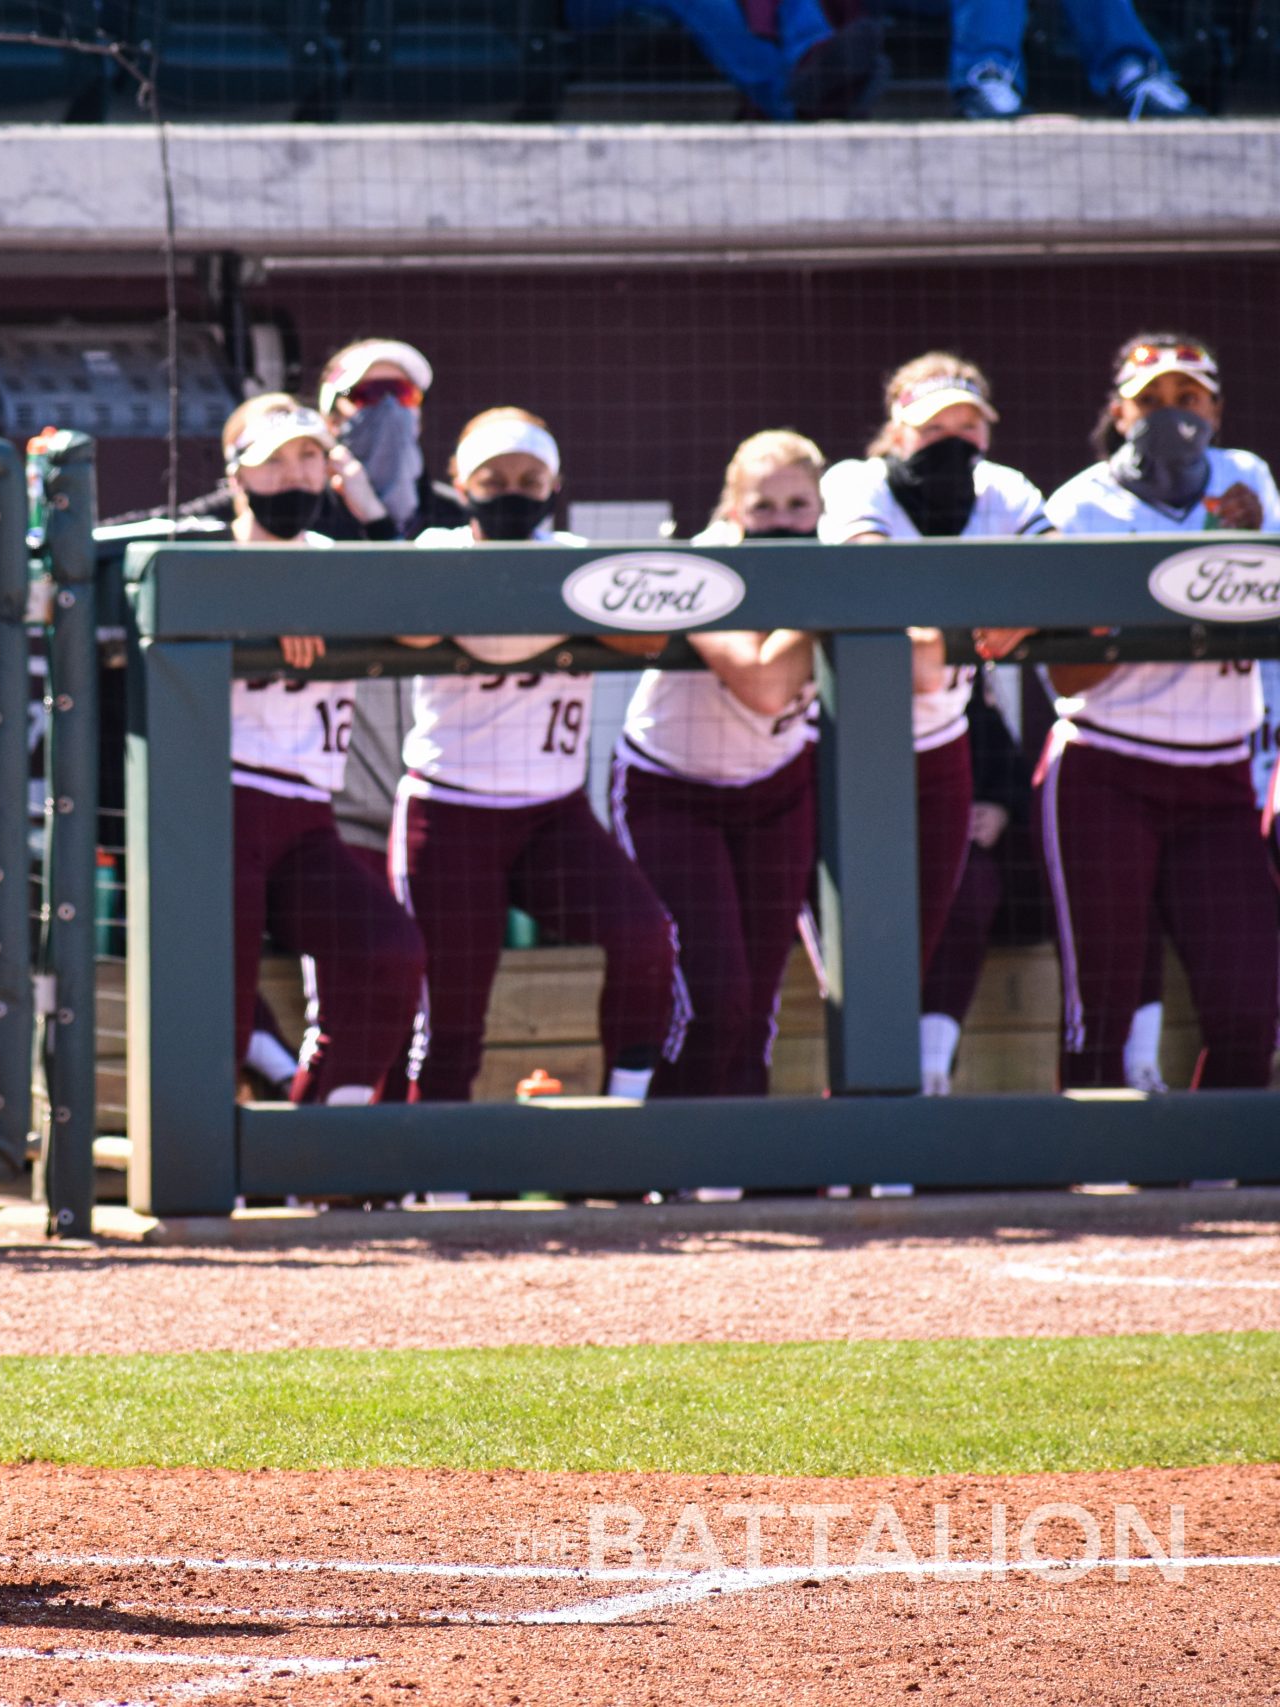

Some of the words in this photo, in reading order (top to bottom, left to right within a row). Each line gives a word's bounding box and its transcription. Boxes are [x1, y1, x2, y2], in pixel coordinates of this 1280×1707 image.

[602, 568, 705, 613] Ford
[316, 699, 355, 753] 12
[542, 699, 583, 755] 19
